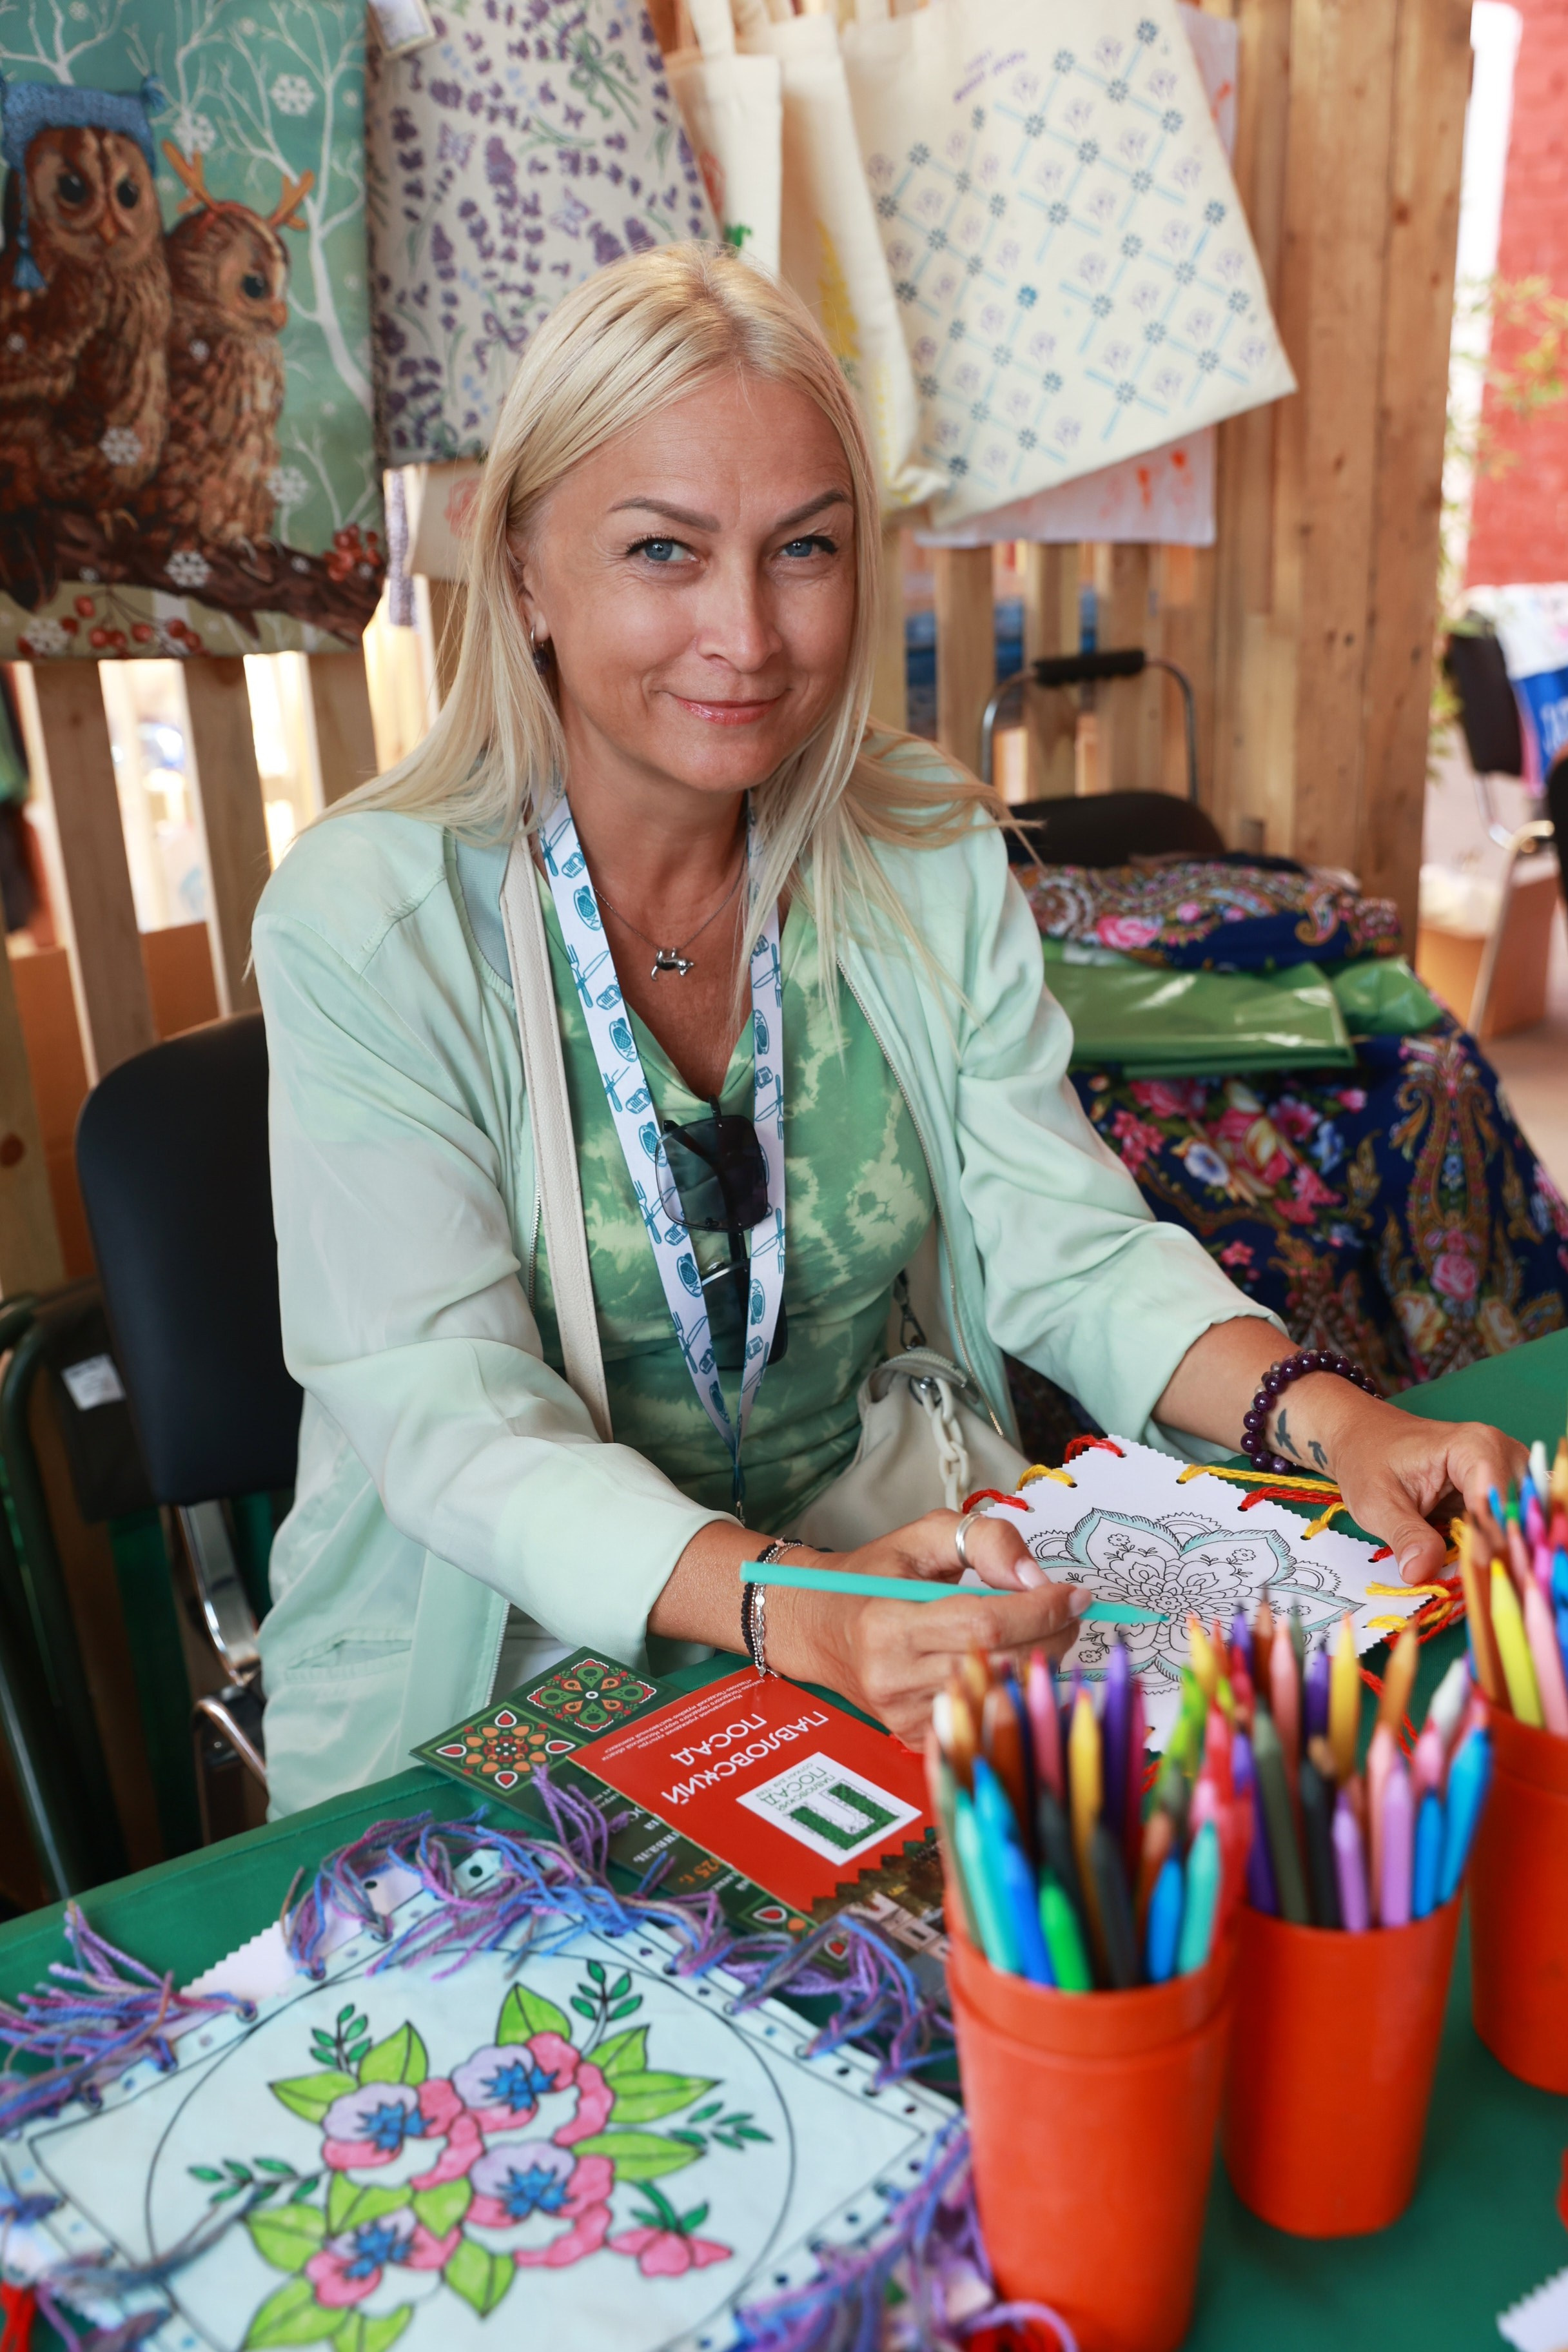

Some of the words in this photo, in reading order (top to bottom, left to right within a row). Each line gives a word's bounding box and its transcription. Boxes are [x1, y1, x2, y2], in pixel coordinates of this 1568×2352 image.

[660, 1711, 828, 1805] ПАВЛОВСКИЙ
[669, 1714, 767, 1767] ПОСАД
[760, 1767, 827, 1805] ПОСАД
[776, 1775, 835, 1811] ПАВЛОВСКИЙ
